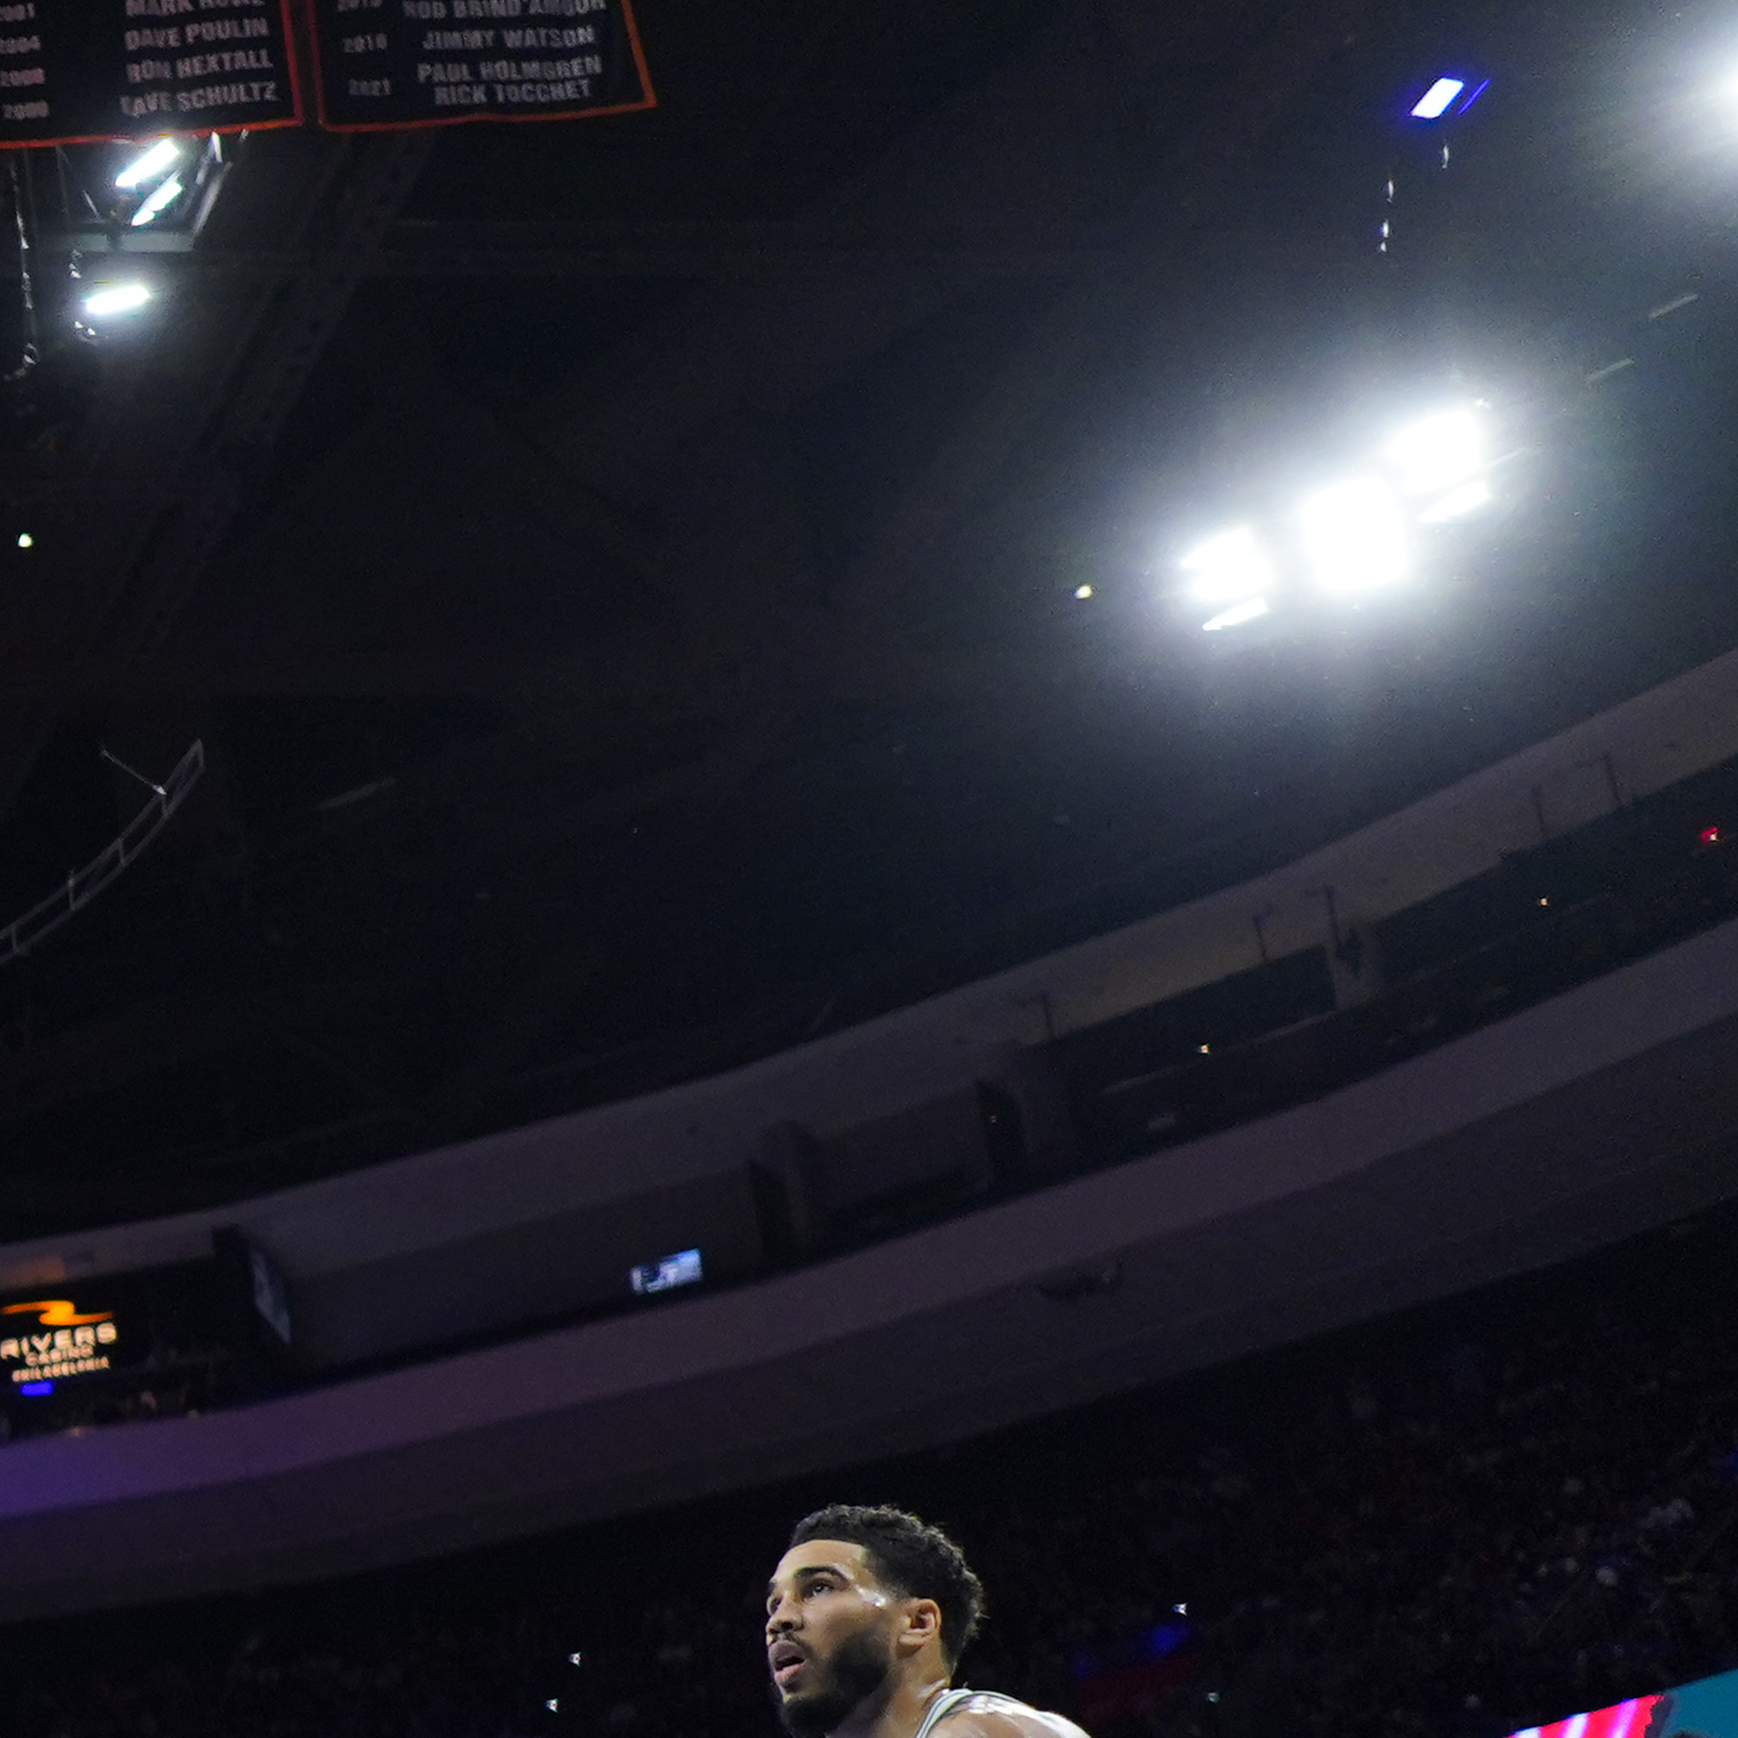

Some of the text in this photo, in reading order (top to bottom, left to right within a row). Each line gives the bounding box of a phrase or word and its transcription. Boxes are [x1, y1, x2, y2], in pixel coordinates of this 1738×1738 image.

[125, 26, 181, 51] DAVE
[184, 17, 269, 45] POULIN
[422, 29, 496, 50] JIMMY
[502, 25, 596, 49] WATSON
[177, 48, 274, 79] HEXTALL
[417, 54, 602, 83] PAUL HOLMGREN
[176, 81, 278, 113] SCHULTZ
[434, 84, 488, 105] RICK
[0, 1322, 117, 1360] RIVERS
